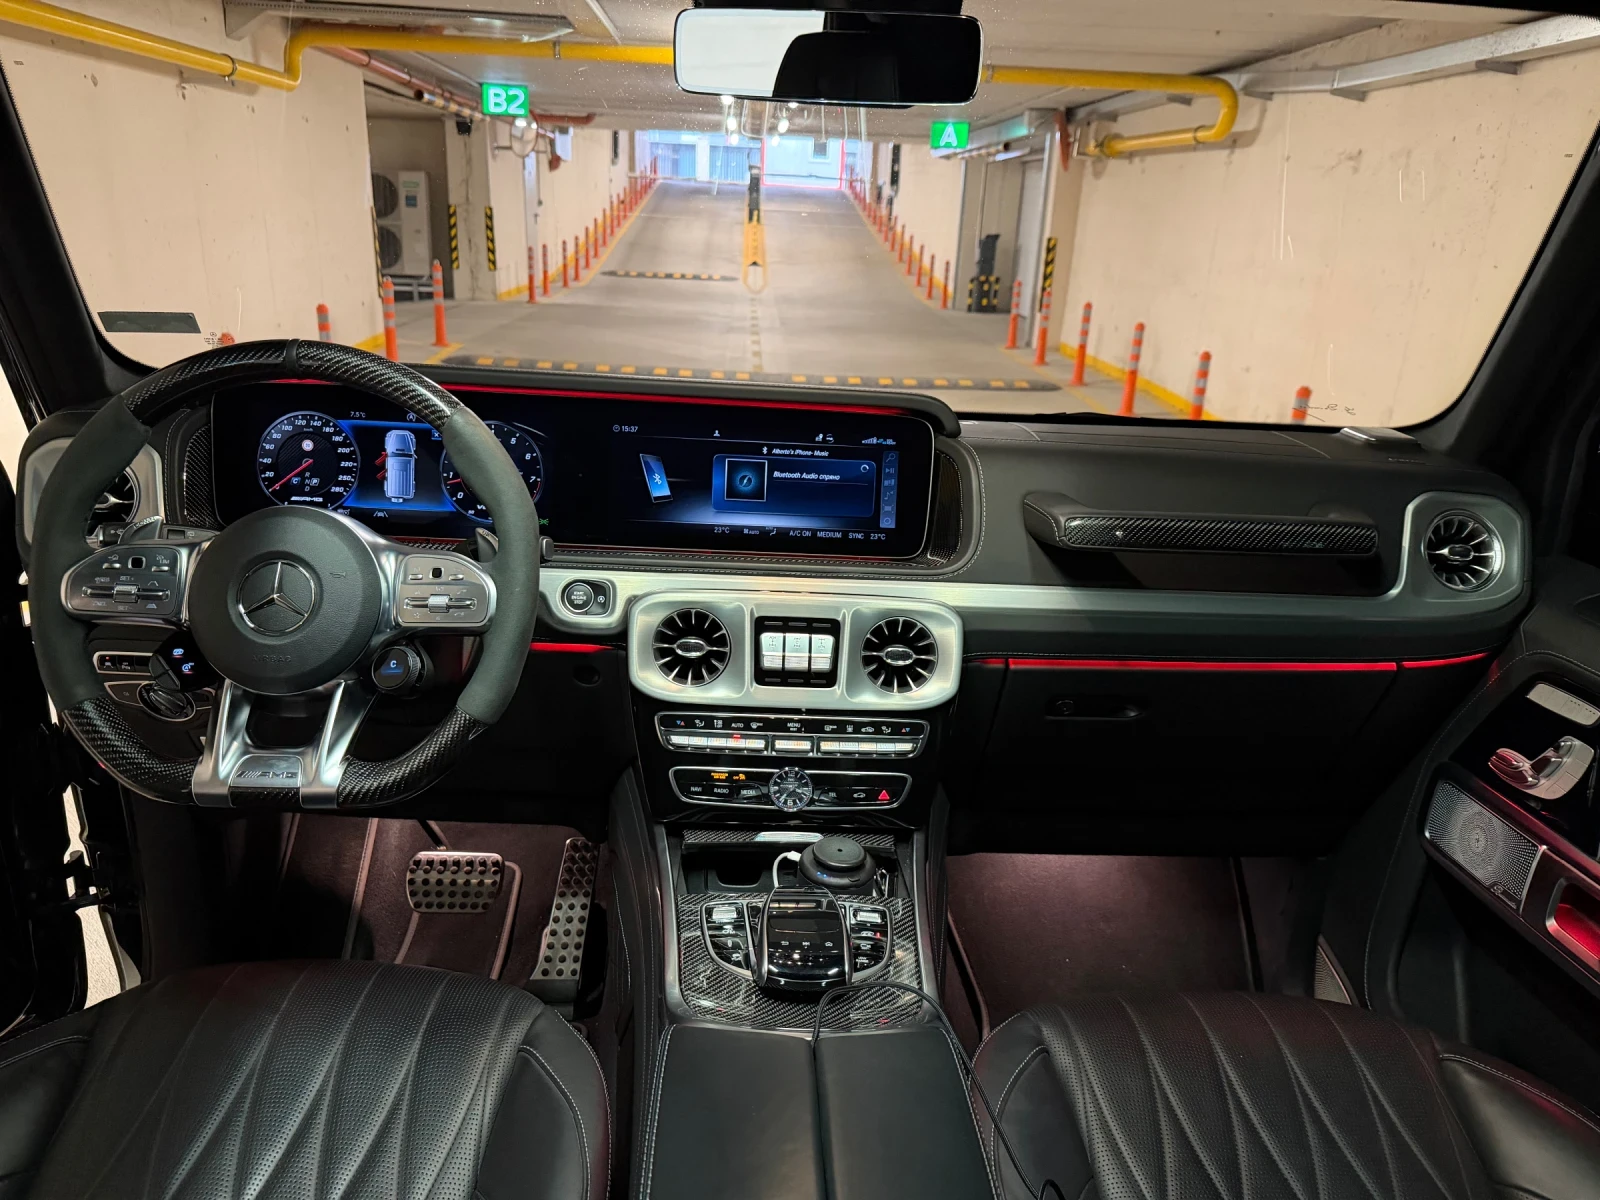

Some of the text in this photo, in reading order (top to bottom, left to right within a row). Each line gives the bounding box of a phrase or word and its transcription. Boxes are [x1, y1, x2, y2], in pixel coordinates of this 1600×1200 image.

[488, 86, 525, 114] B2
[939, 122, 958, 147] A
[621, 425, 638, 433] 15:37
[510, 437, 516, 445] 5
[773, 471, 801, 480] Bluetooth
[801, 472, 818, 480] Audio
[714, 526, 730, 534] 23°C
[816, 531, 842, 539] MEDIUM
[848, 532, 865, 540] SYNC
[870, 533, 886, 541] 23°C
[390, 660, 397, 668] C
